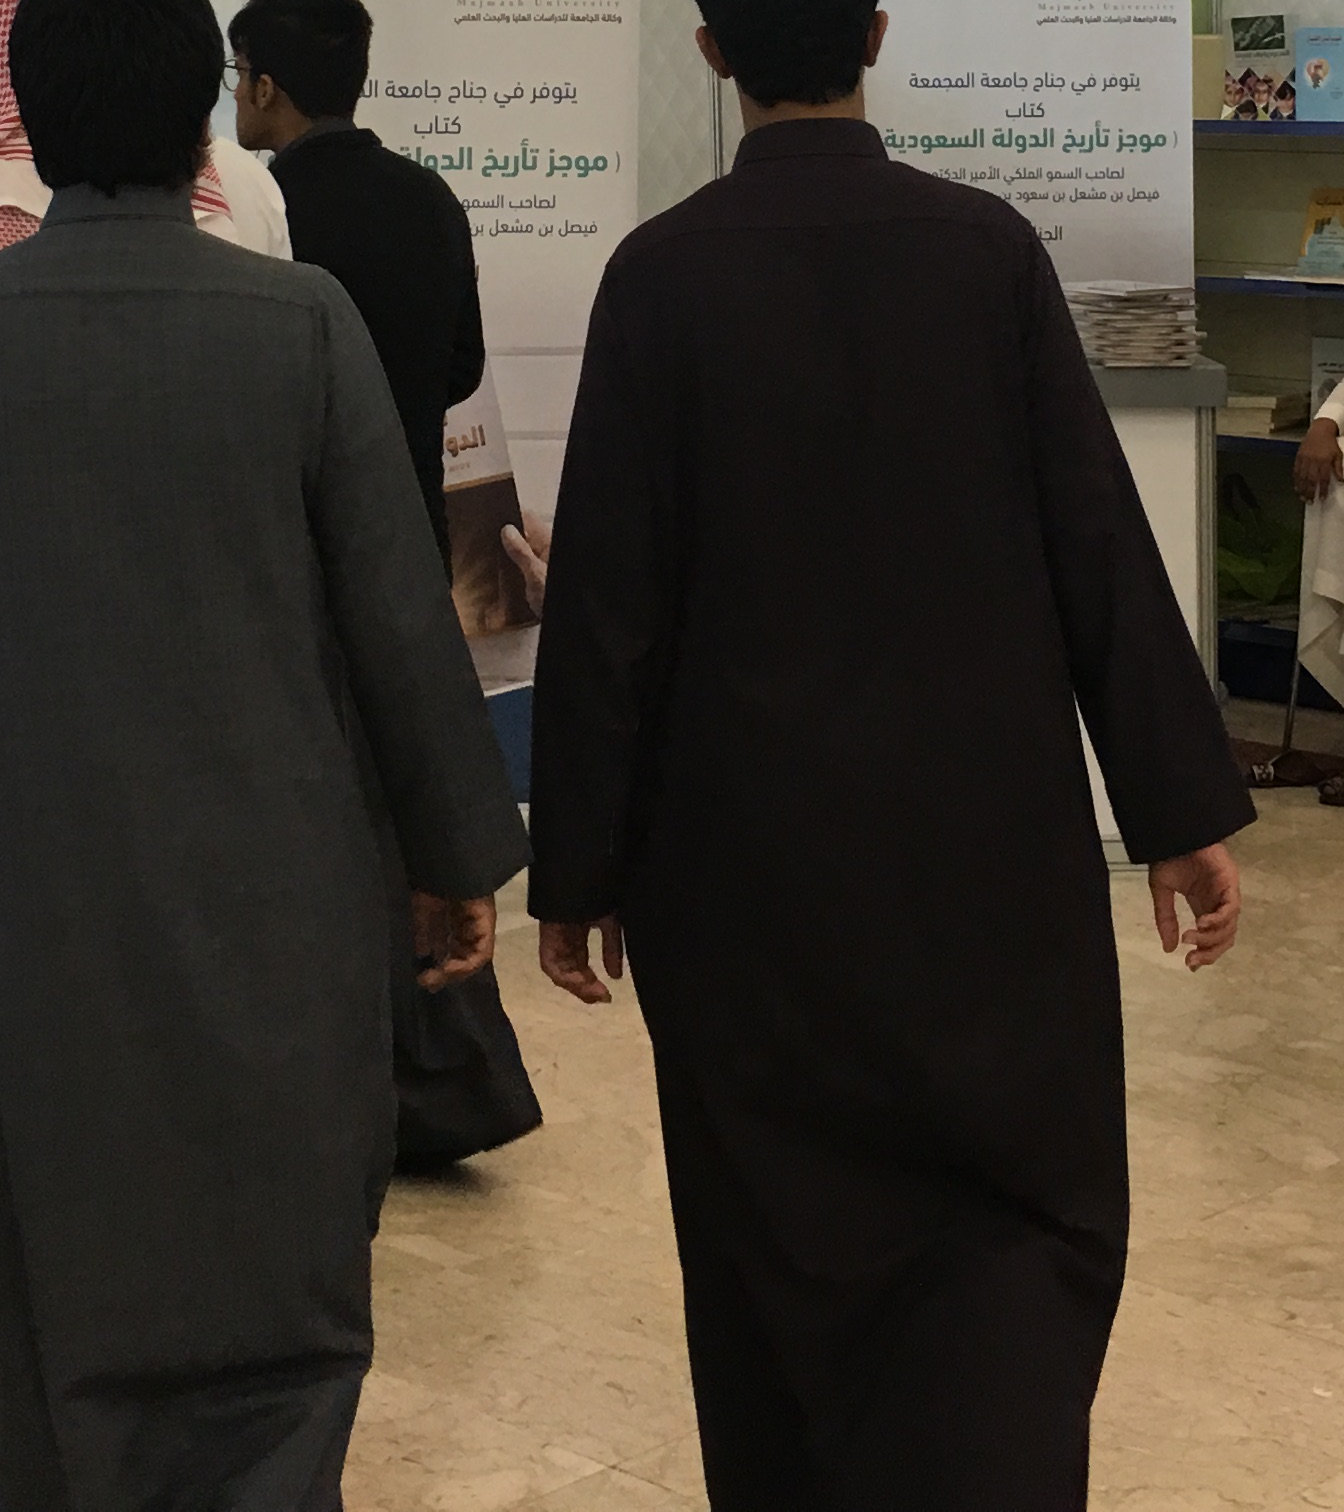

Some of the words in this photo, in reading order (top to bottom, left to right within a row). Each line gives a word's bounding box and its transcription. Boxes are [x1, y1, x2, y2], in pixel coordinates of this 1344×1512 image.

[384, 79, 442, 104] جامعة
[447, 79, 487, 104] جناح
[908, 72, 975, 93] المجمعة
[980, 72, 1028, 92] جامعة
[1033, 72, 1066, 92] جناح
[1070, 74, 1097, 96] في
[1101, 74, 1140, 93] يتوفر
[493, 81, 525, 109] في
[529, 80, 578, 105] يتوفر
[1005, 101, 1045, 121] كتاب
[413, 115, 462, 139] كتاب
[1061, 120, 1110, 153] تأريخ
[883, 128, 985, 154] السعودية
[991, 128, 1055, 153] الدولة
[1115, 130, 1168, 153] موجز
[480, 138, 540, 178] تأريخ
[545, 150, 609, 178] موجز
[928, 167, 967, 181] الدكتو
[969, 166, 1000, 183] الأمير
[1002, 167, 1043, 183] الملكي
[1045, 167, 1082, 182] السمو
[1084, 167, 1125, 181] لصاحب
[507, 194, 556, 213] لصاحب
[1015, 190, 1049, 204] سعود
[1051, 191, 1067, 203] بن
[1068, 187, 1107, 203] مشعل
[1109, 191, 1124, 203] بن
[1126, 188, 1160, 203] فيصل
[489, 218, 534, 238] مشعل
[538, 223, 554, 238] بن
[557, 219, 598, 238] فيصل
[1032, 225, 1064, 242] الجنا
[444, 423, 486, 458] الدو
